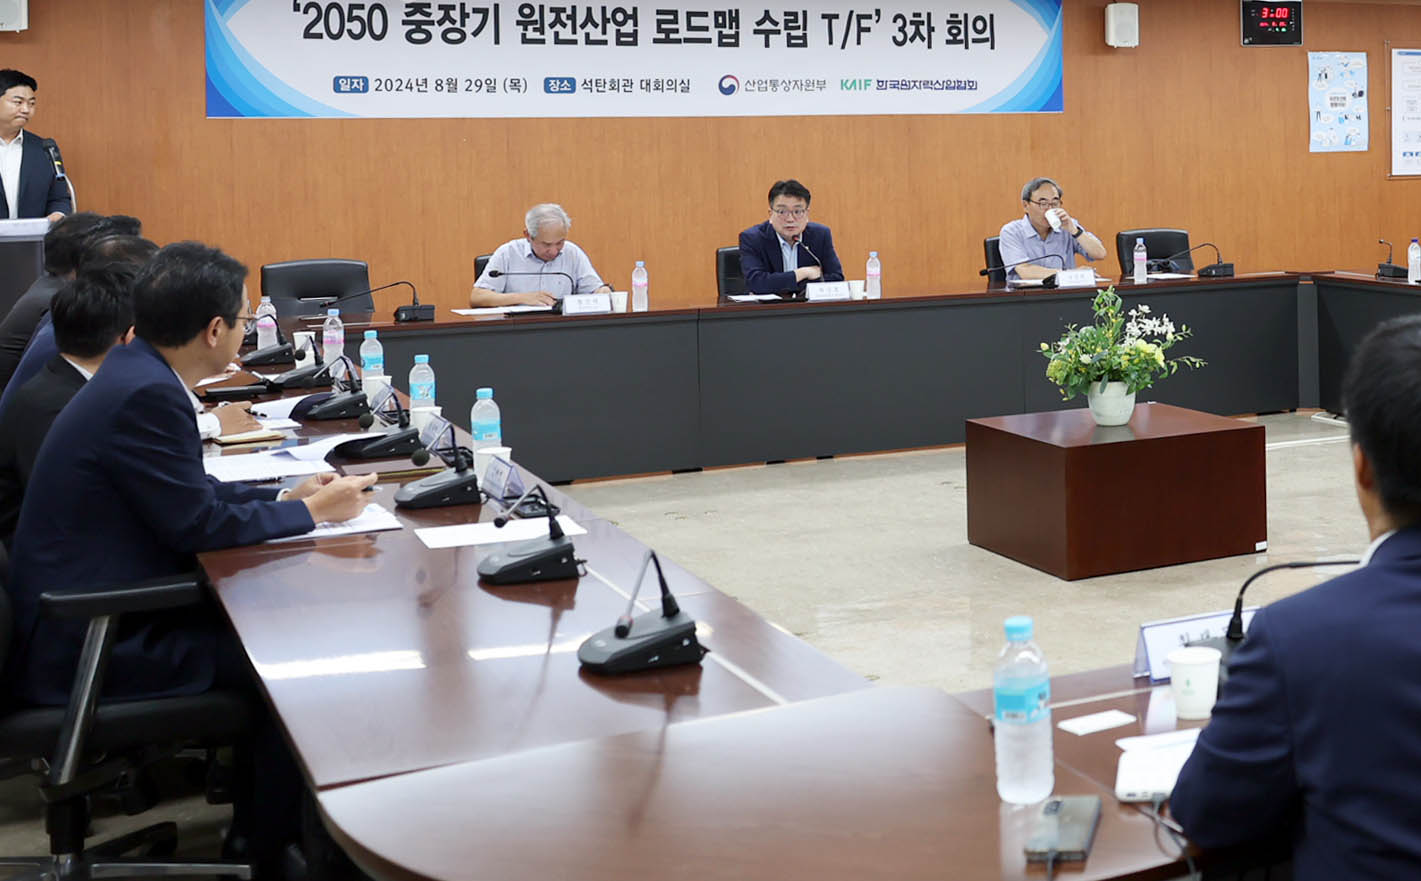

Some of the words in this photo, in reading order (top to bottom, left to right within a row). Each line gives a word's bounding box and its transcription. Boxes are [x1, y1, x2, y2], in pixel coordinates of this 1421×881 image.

[1261, 7, 1289, 19] 3:00
[401, 2, 500, 46] 중장기
[515, 3, 639, 47] 원전산업
[652, 8, 740, 48] 로드맵
[752, 10, 808, 49] 수립
[891, 12, 936, 50] 3차
[945, 13, 996, 50] 회의
[338, 78, 366, 92] 일자
[374, 78, 428, 93] 2024년
[434, 78, 458, 93] 8월
[464, 78, 497, 93] 29일
[502, 78, 528, 94] (목)
[548, 78, 573, 92] 장소
[581, 78, 634, 93] 석탄회관
[640, 78, 691, 93] 대회의실
[744, 79, 827, 93] 산업통상자원부
[840, 79, 873, 91] KAIF
[876, 79, 978, 91] 한국원자력산업협회
